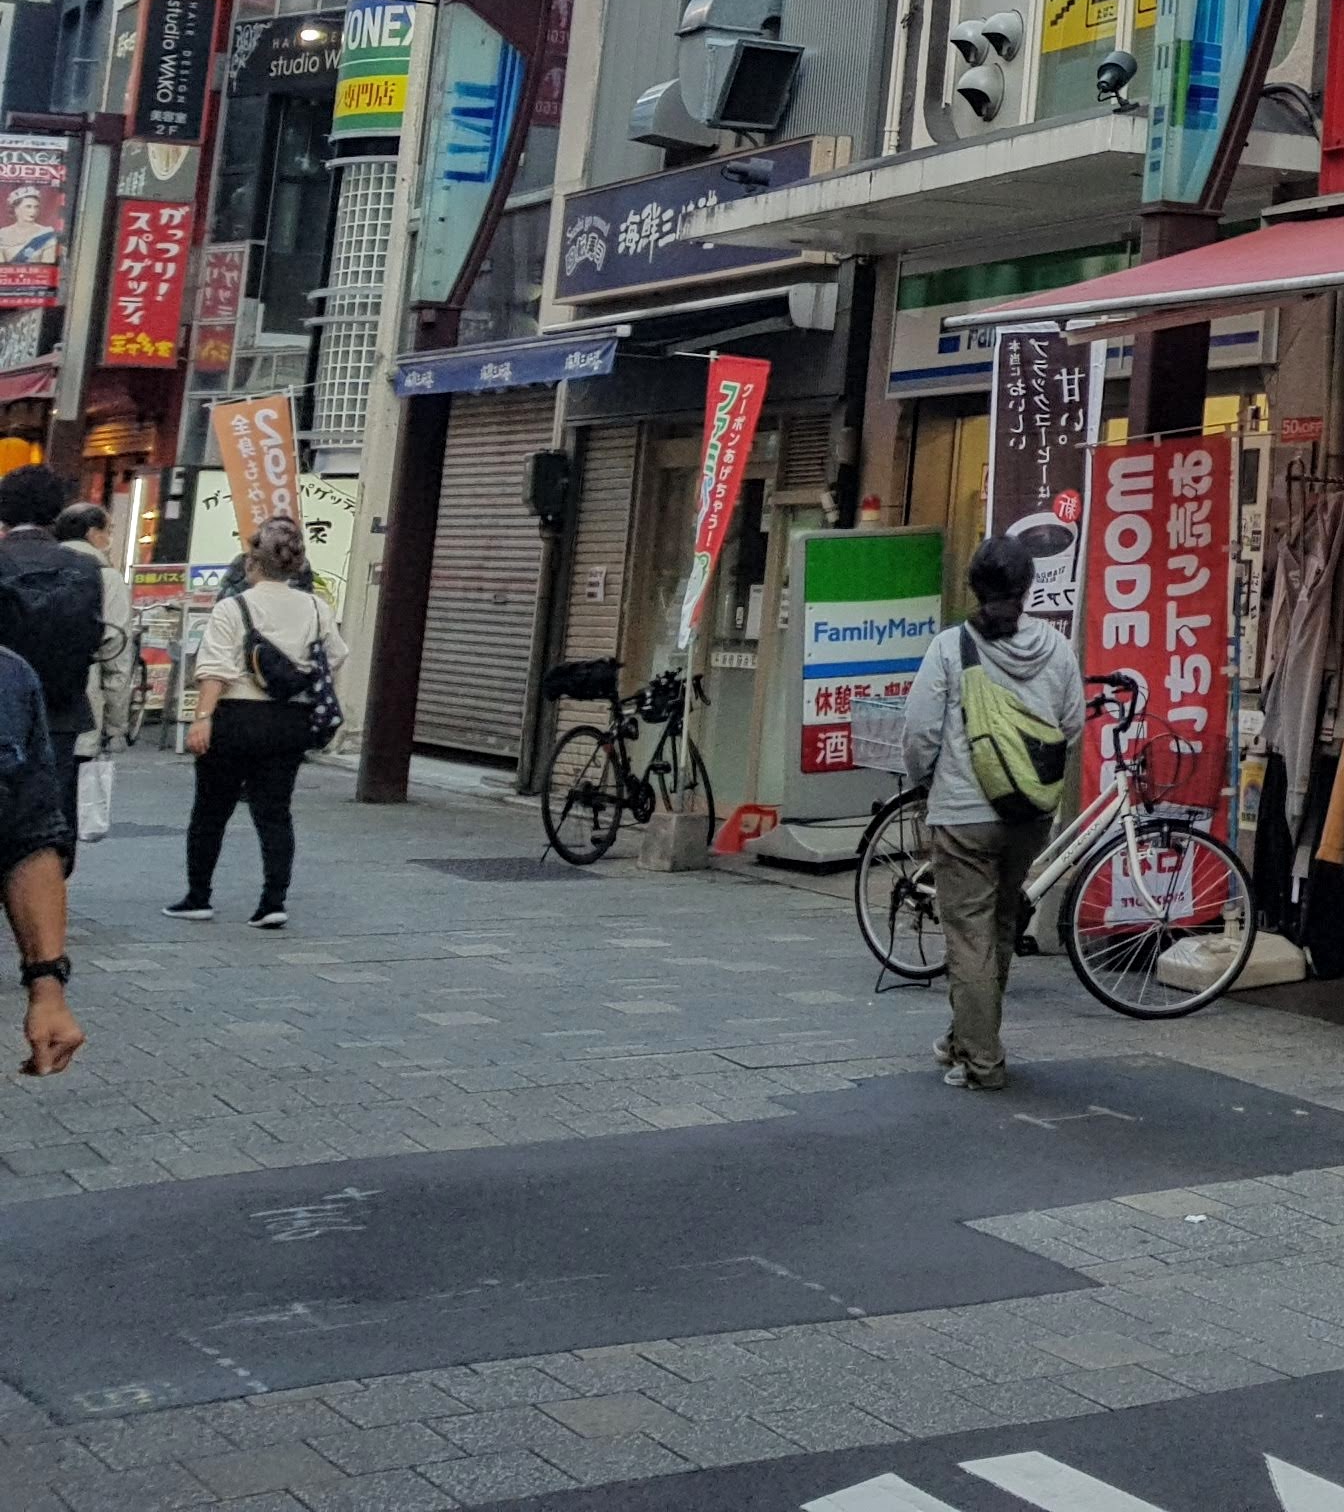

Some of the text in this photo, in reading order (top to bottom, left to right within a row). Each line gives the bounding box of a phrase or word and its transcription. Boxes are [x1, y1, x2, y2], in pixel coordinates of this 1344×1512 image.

[156, 0, 182, 104] studio WAKO
[269, 55, 319, 77] studio
[117, 211, 154, 326] スパゲッティ
[813, 616, 936, 645] FamilyMart
